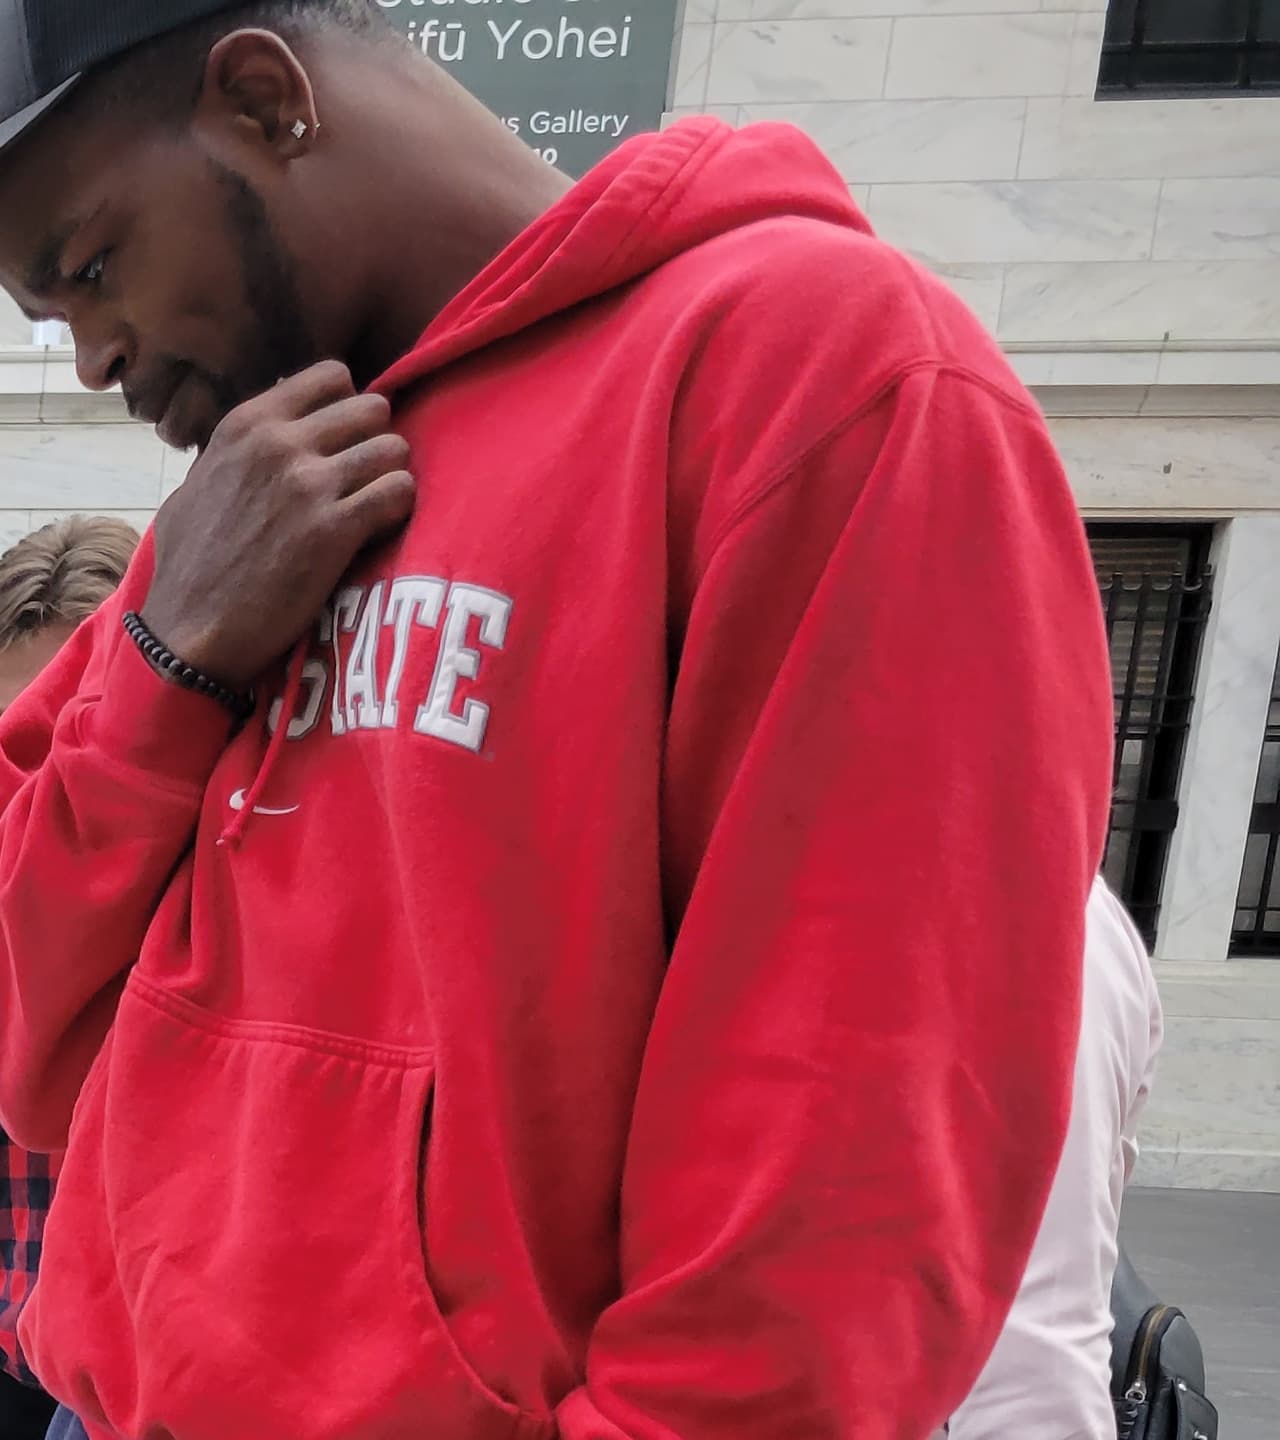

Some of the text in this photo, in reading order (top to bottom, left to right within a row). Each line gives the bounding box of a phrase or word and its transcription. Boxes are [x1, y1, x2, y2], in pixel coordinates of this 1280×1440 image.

[407, 16, 632, 61] ifū Yohei
[529, 109, 630, 137] Gallery
